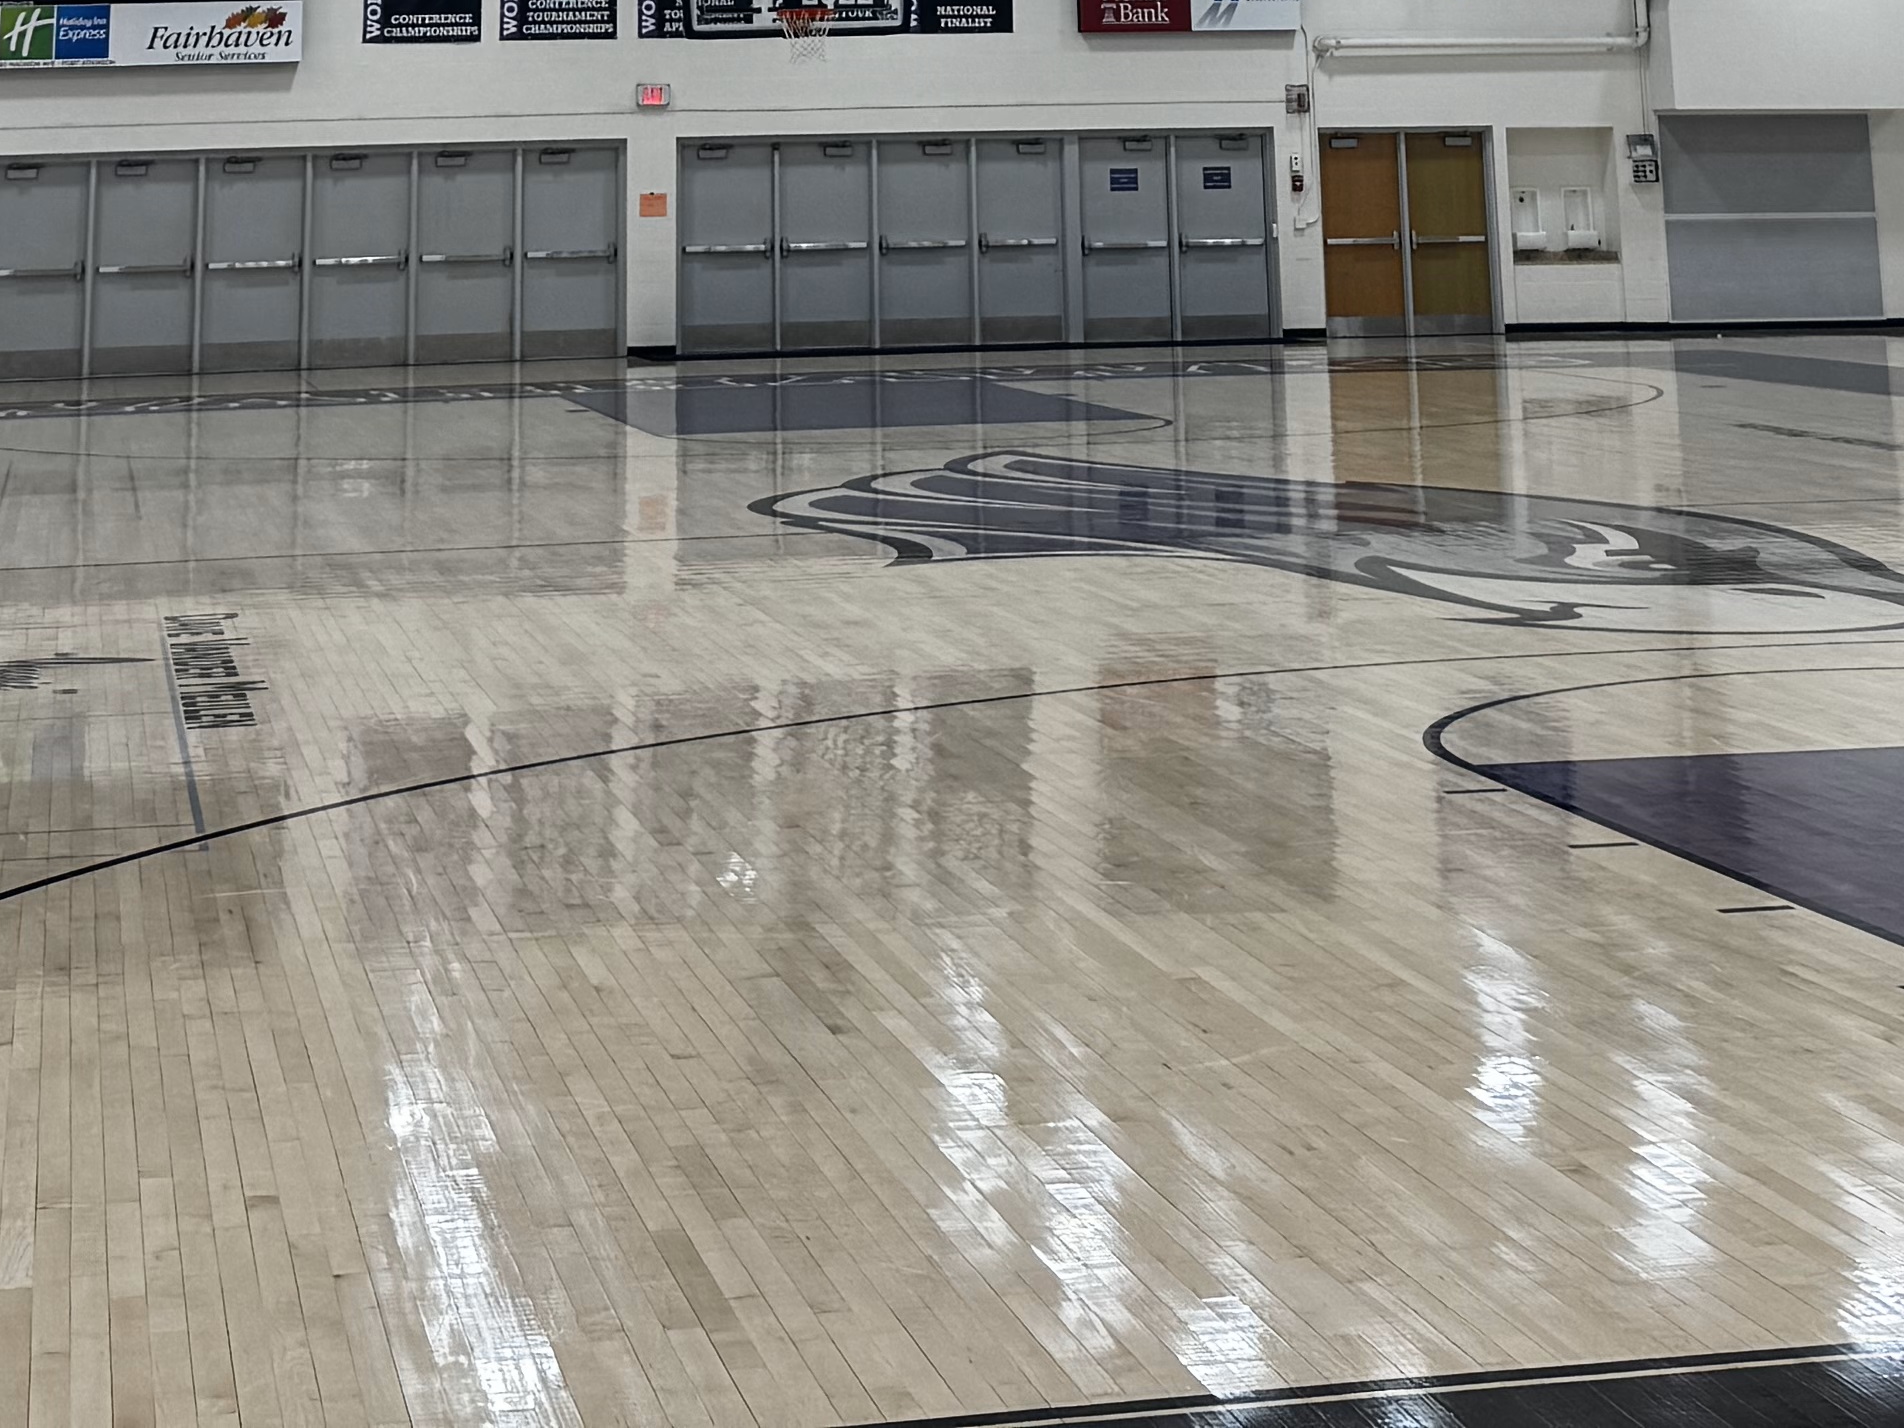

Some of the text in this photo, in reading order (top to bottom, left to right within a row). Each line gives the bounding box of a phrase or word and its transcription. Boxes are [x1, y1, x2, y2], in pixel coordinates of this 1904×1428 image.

[937, 6, 996, 15] NATIONAL
[1120, 2, 1170, 22] Bank
[391, 14, 473, 24] CONFERENCE
[527, 11, 610, 21] TOURNAMENT
[59, 17, 107, 27] Holiday Inn
[940, 18, 993, 28] FINALIST
[384, 26, 479, 36] CHAMPIONSHIPS
[523, 23, 614, 34] CHAMPIONSHIPS
[59, 27, 107, 42] Express
[146, 25, 293, 50] Fairhaven
[176, 680, 269, 730] MEULEN
